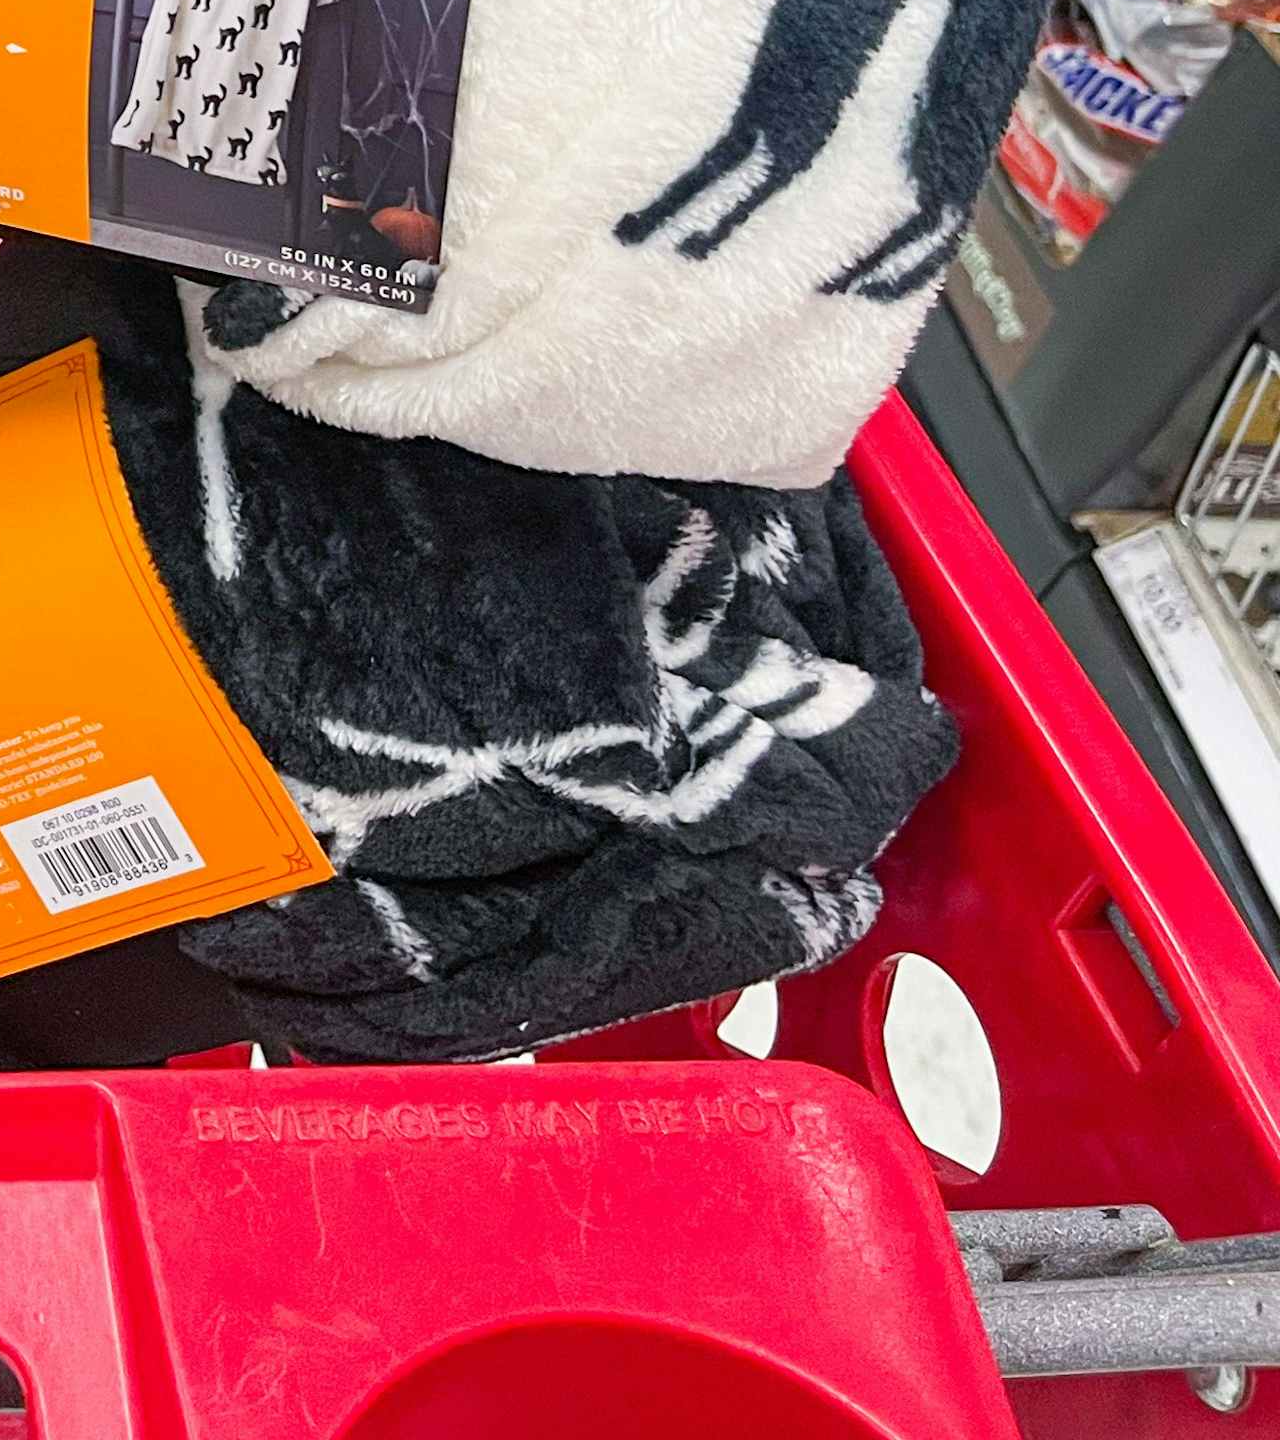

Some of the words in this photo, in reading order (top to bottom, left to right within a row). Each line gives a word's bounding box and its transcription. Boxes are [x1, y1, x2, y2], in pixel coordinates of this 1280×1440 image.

[224, 250, 262, 270] (127
[268, 262, 296, 279] CM
[301, 269, 315, 283] X
[320, 272, 372, 295] 152.4
[379, 286, 416, 305] CM)
[280, 246, 307, 263] 50
[314, 253, 335, 270] IN
[341, 259, 355, 274] X
[360, 263, 388, 280] 60
[395, 270, 416, 287] IN
[73, 875, 120, 897] 91908
[122, 859, 169, 883] 88436
[185, 853, 193, 864] 3
[191, 1102, 489, 1144] BEVERAGES
[506, 1099, 602, 1140] MAY
[616, 1098, 692, 1136] BE
[697, 1096, 796, 1136] HOT
